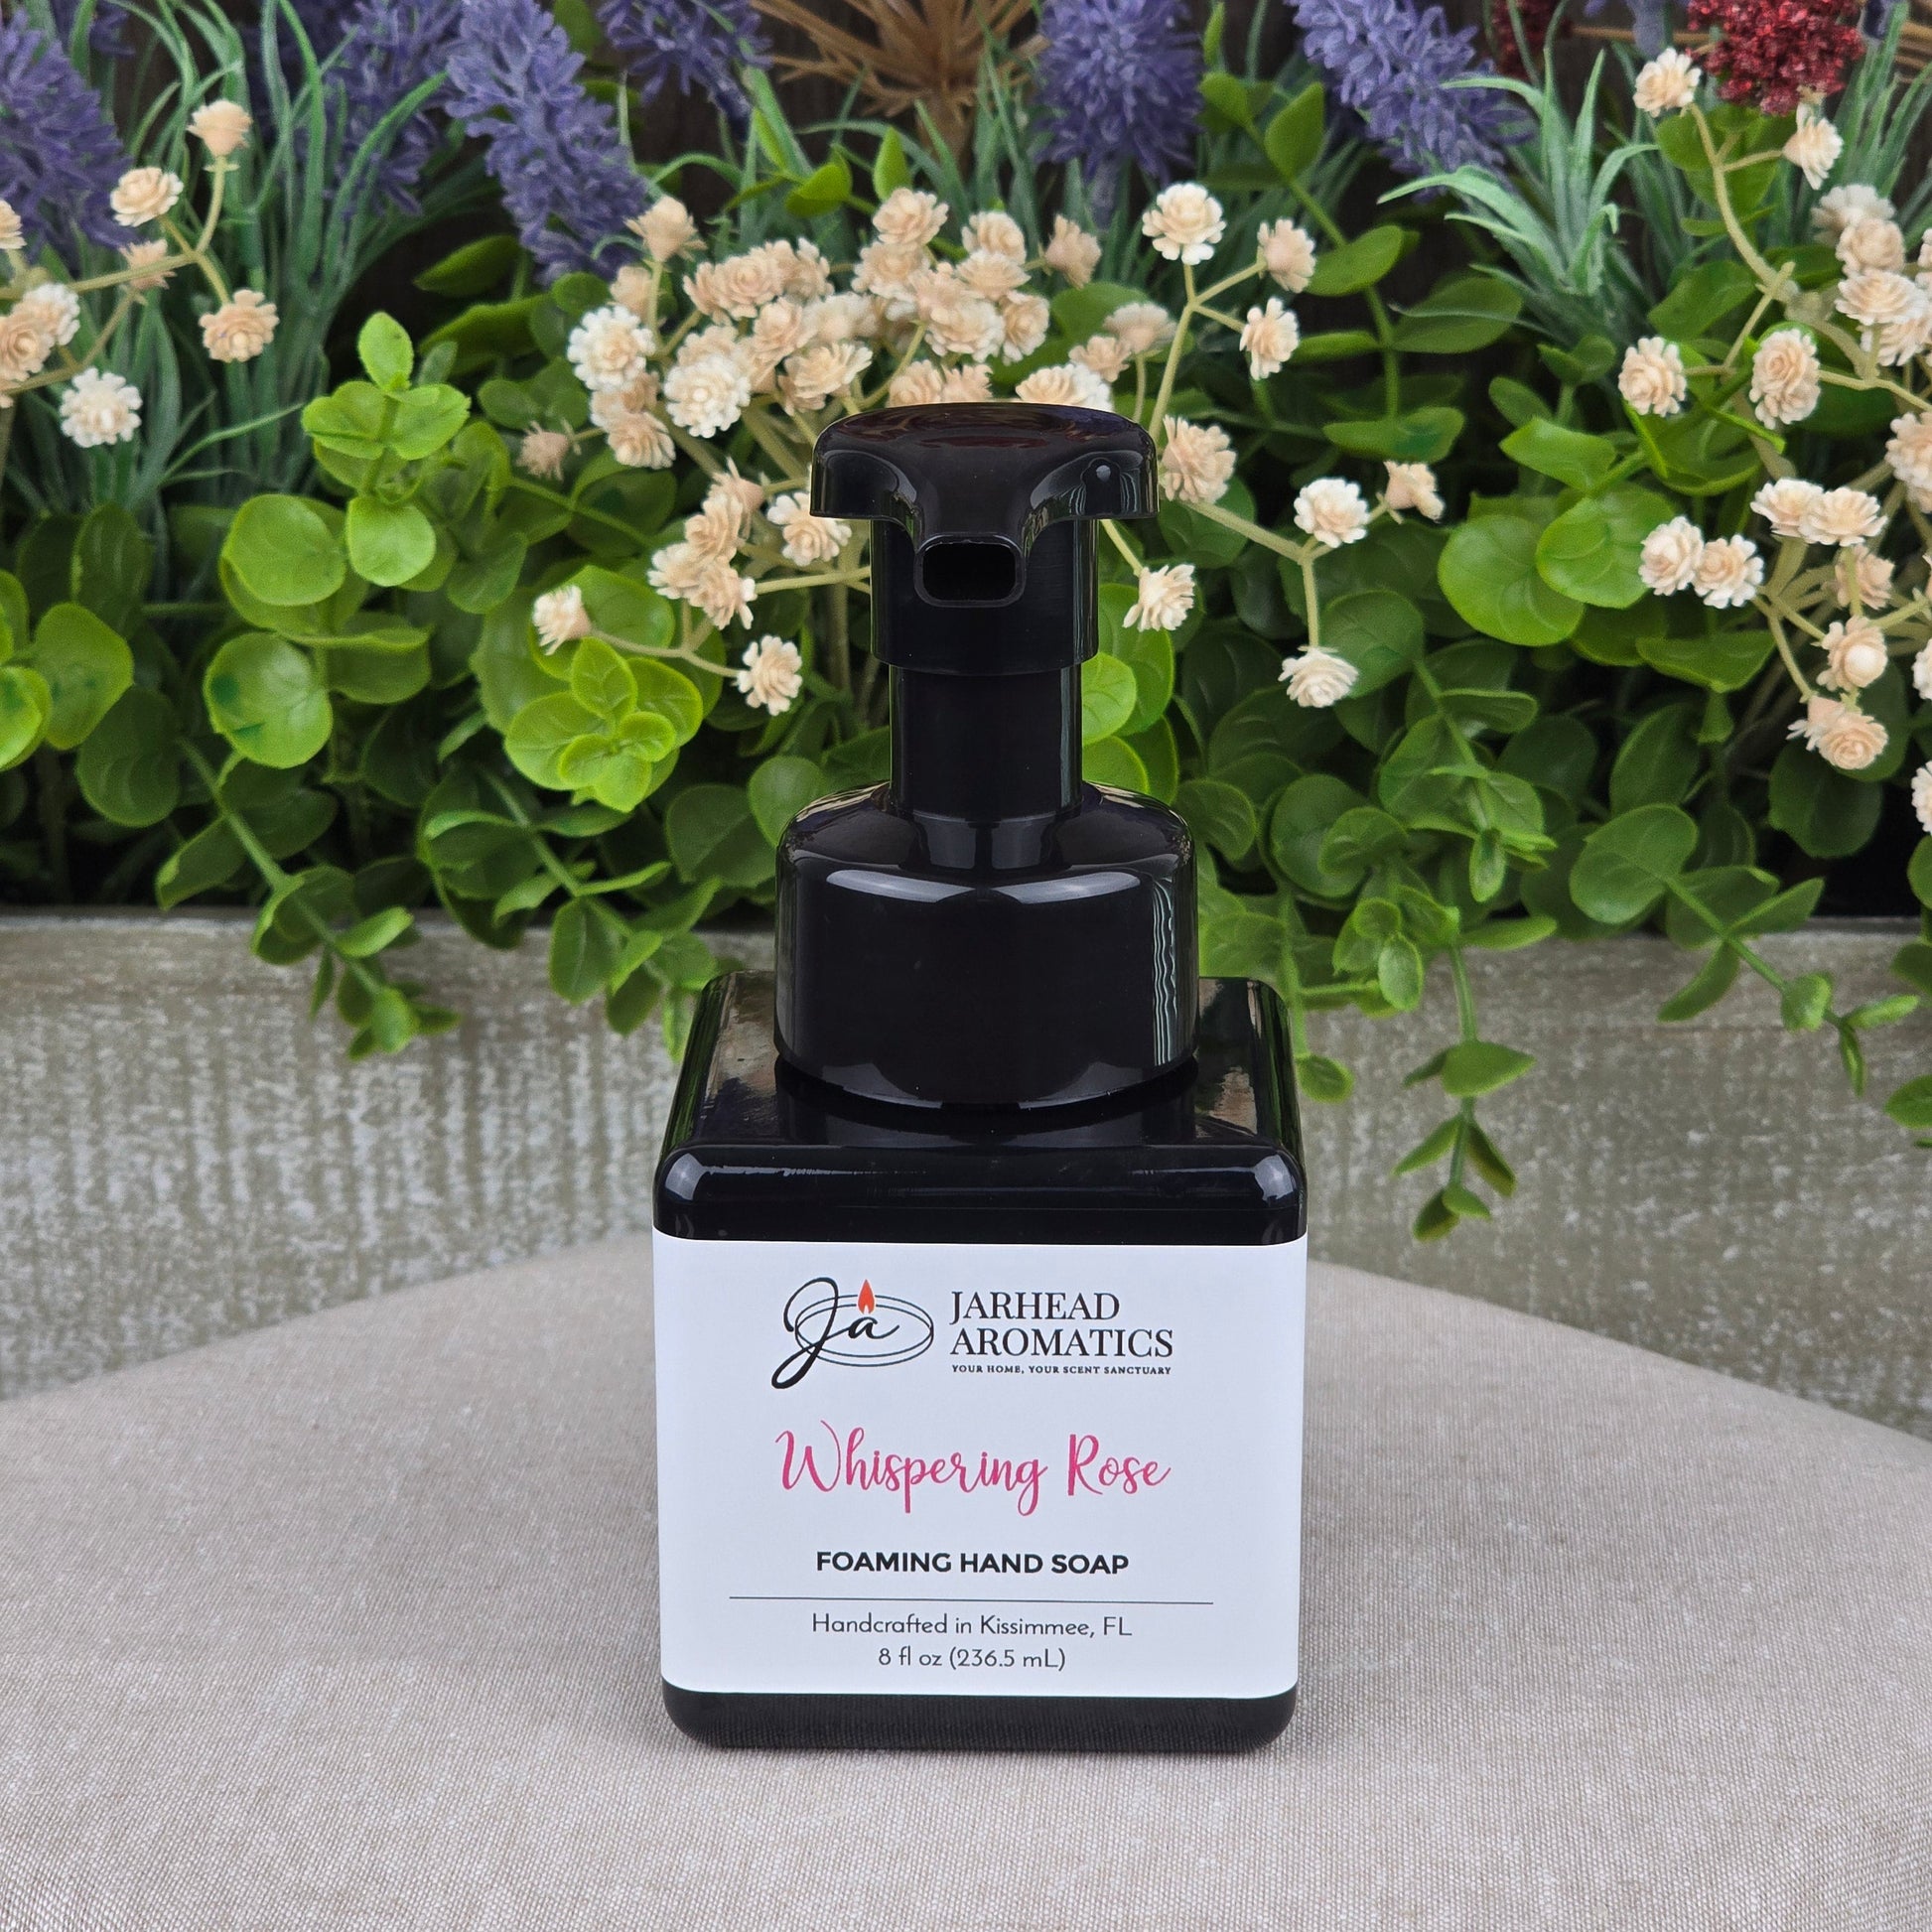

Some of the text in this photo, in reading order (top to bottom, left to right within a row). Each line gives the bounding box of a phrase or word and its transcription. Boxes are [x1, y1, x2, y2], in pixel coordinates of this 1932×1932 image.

[948, 1291, 1120, 1325] JARHEAD
[949, 1326, 1173, 1358] AROMATICS
[951, 1364, 1172, 1375] YOUR HOME, YOUR SCENT SANCTUARY
[774, 1420, 1172, 1517] Whispering Rose
[816, 1551, 1130, 1575] FOAMING HAND SOAP
[812, 1611, 1133, 1639] Handcrafted in Kissimmee, FL
[878, 1644, 1066, 1672] 8 fl oz (236.5 mL)
